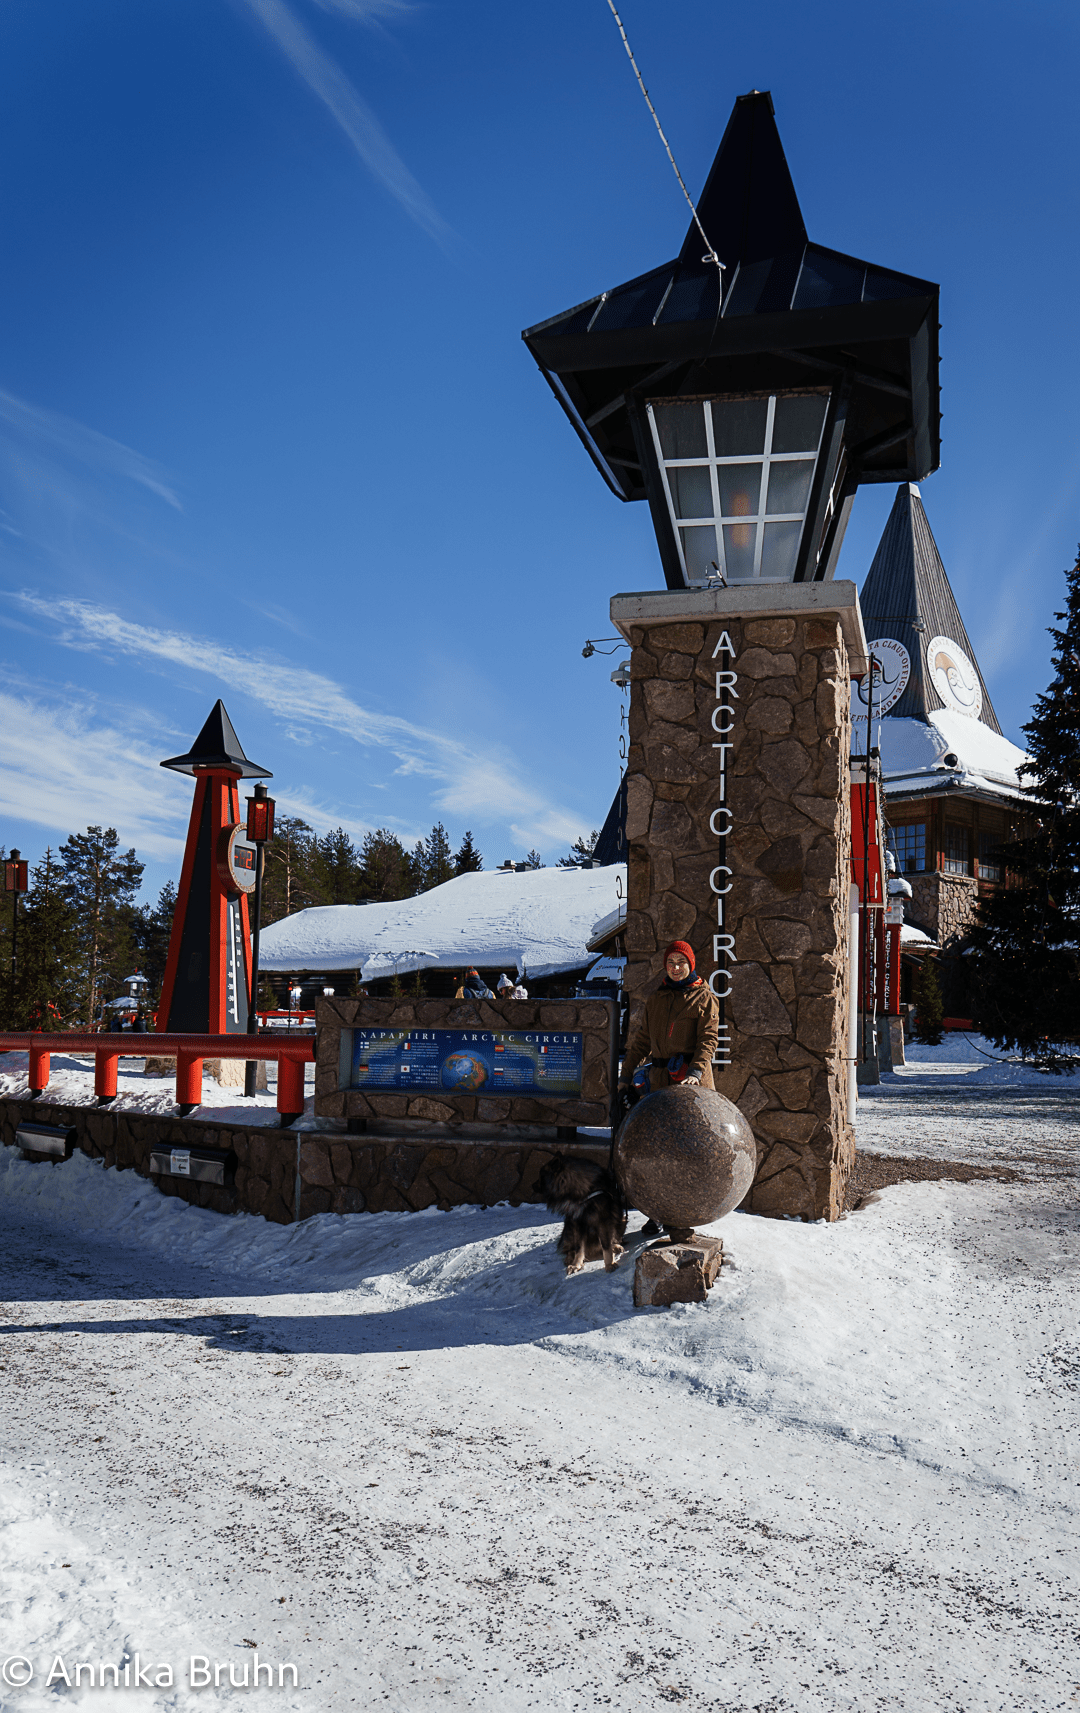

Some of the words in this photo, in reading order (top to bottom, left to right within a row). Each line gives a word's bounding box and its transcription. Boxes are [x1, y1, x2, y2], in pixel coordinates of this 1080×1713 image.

[882, 641, 906, 658] CLAUS
[896, 657, 909, 694] OFFICE
[709, 631, 739, 836] ARCTIC
[360, 1031, 436, 1040] NAPAPIIRI
[461, 1033, 515, 1042] ARCTIC
[525, 1035, 579, 1043] CIRCLE
